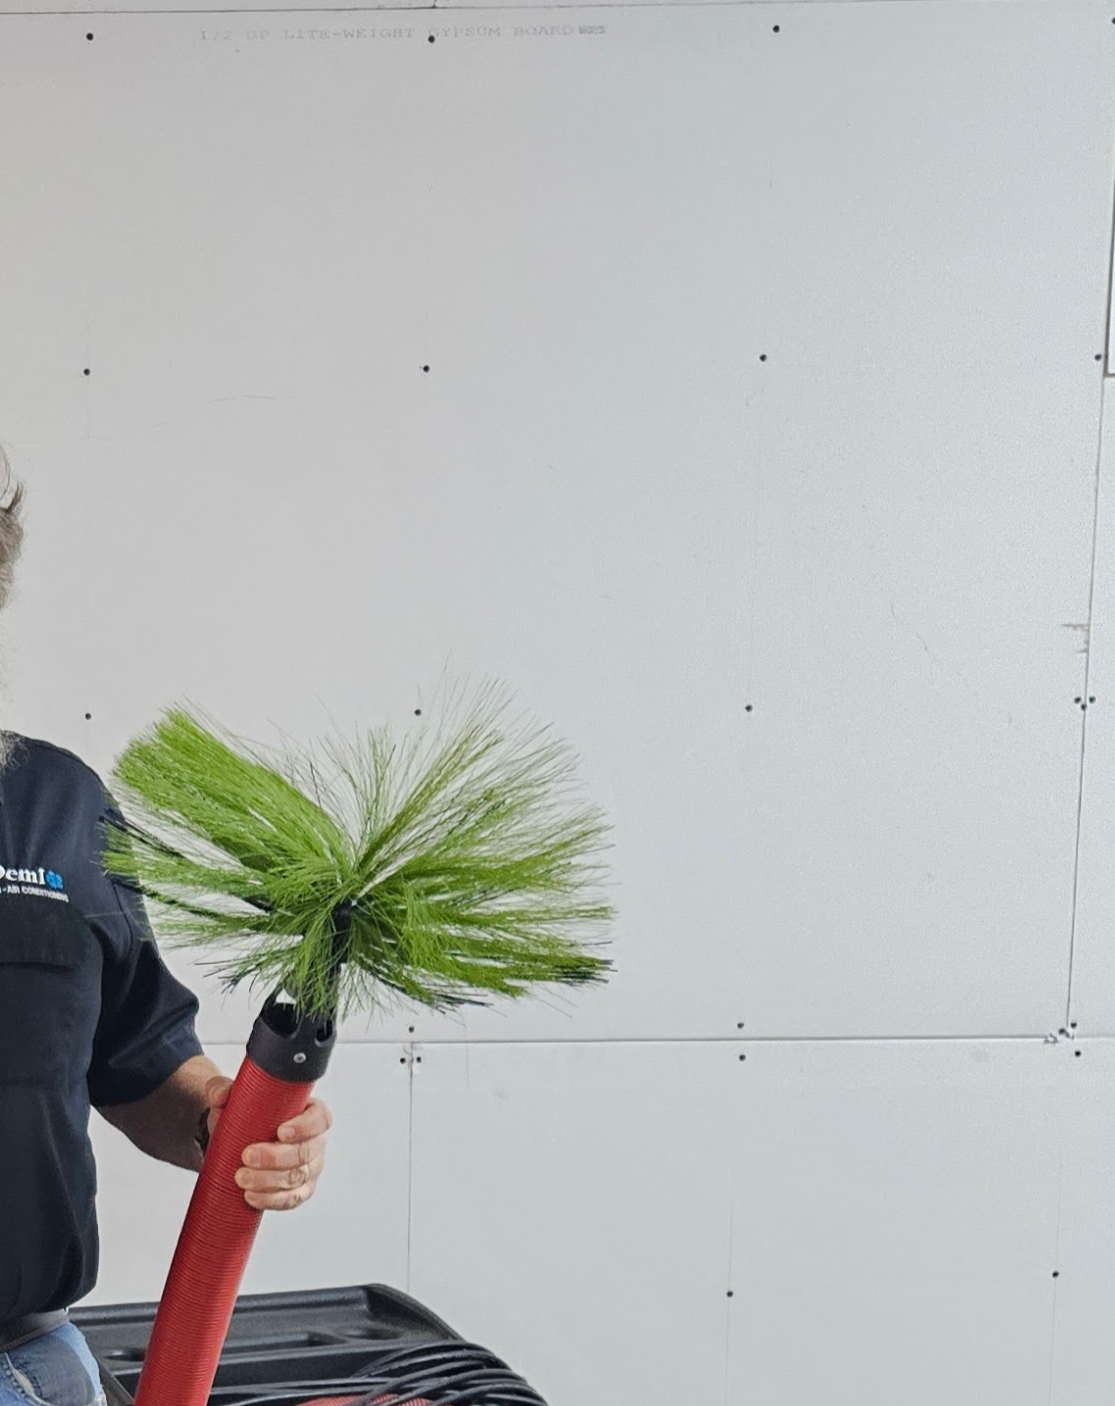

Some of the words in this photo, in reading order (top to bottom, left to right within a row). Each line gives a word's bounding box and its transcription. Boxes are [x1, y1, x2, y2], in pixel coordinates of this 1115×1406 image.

[283, 27, 415, 40] LITE-WEIGHT
[427, 25, 503, 39] GYPSUM
[513, 25, 574, 38] BOARD
